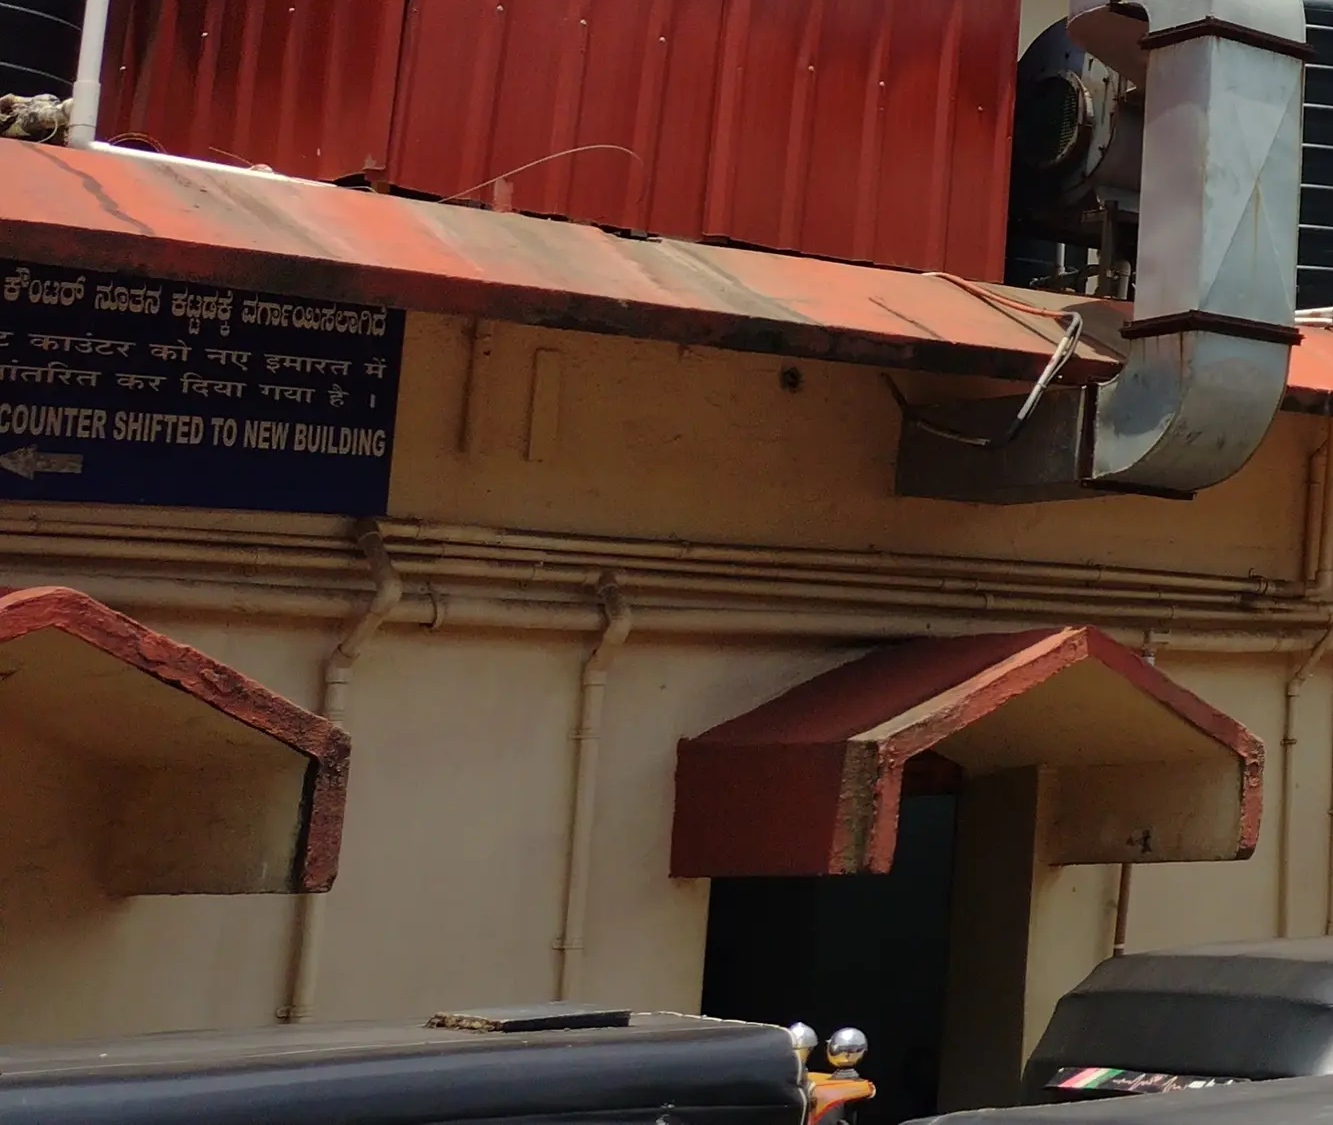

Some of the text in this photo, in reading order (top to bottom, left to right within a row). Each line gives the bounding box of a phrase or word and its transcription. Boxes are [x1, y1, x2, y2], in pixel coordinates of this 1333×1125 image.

[4, 267, 387, 337] ಕೌಂಟರ್ ನೂತನ ಕಟ್ಟಡಕ್ಕೆ ವರ್ಗಾಯಿಸಲಾಗಿದೆ
[28, 332, 136, 357] काउंटर
[149, 339, 192, 362] को
[205, 348, 252, 371] नए
[264, 353, 352, 375] इमारत
[364, 357, 387, 379] में
[115, 373, 167, 392] कर
[180, 372, 247, 398] दिया
[258, 383, 316, 404] गया
[327, 383, 349, 407] है
[0, 402, 386, 457] COUNTER SHIFTED TO NEW BUILDING
